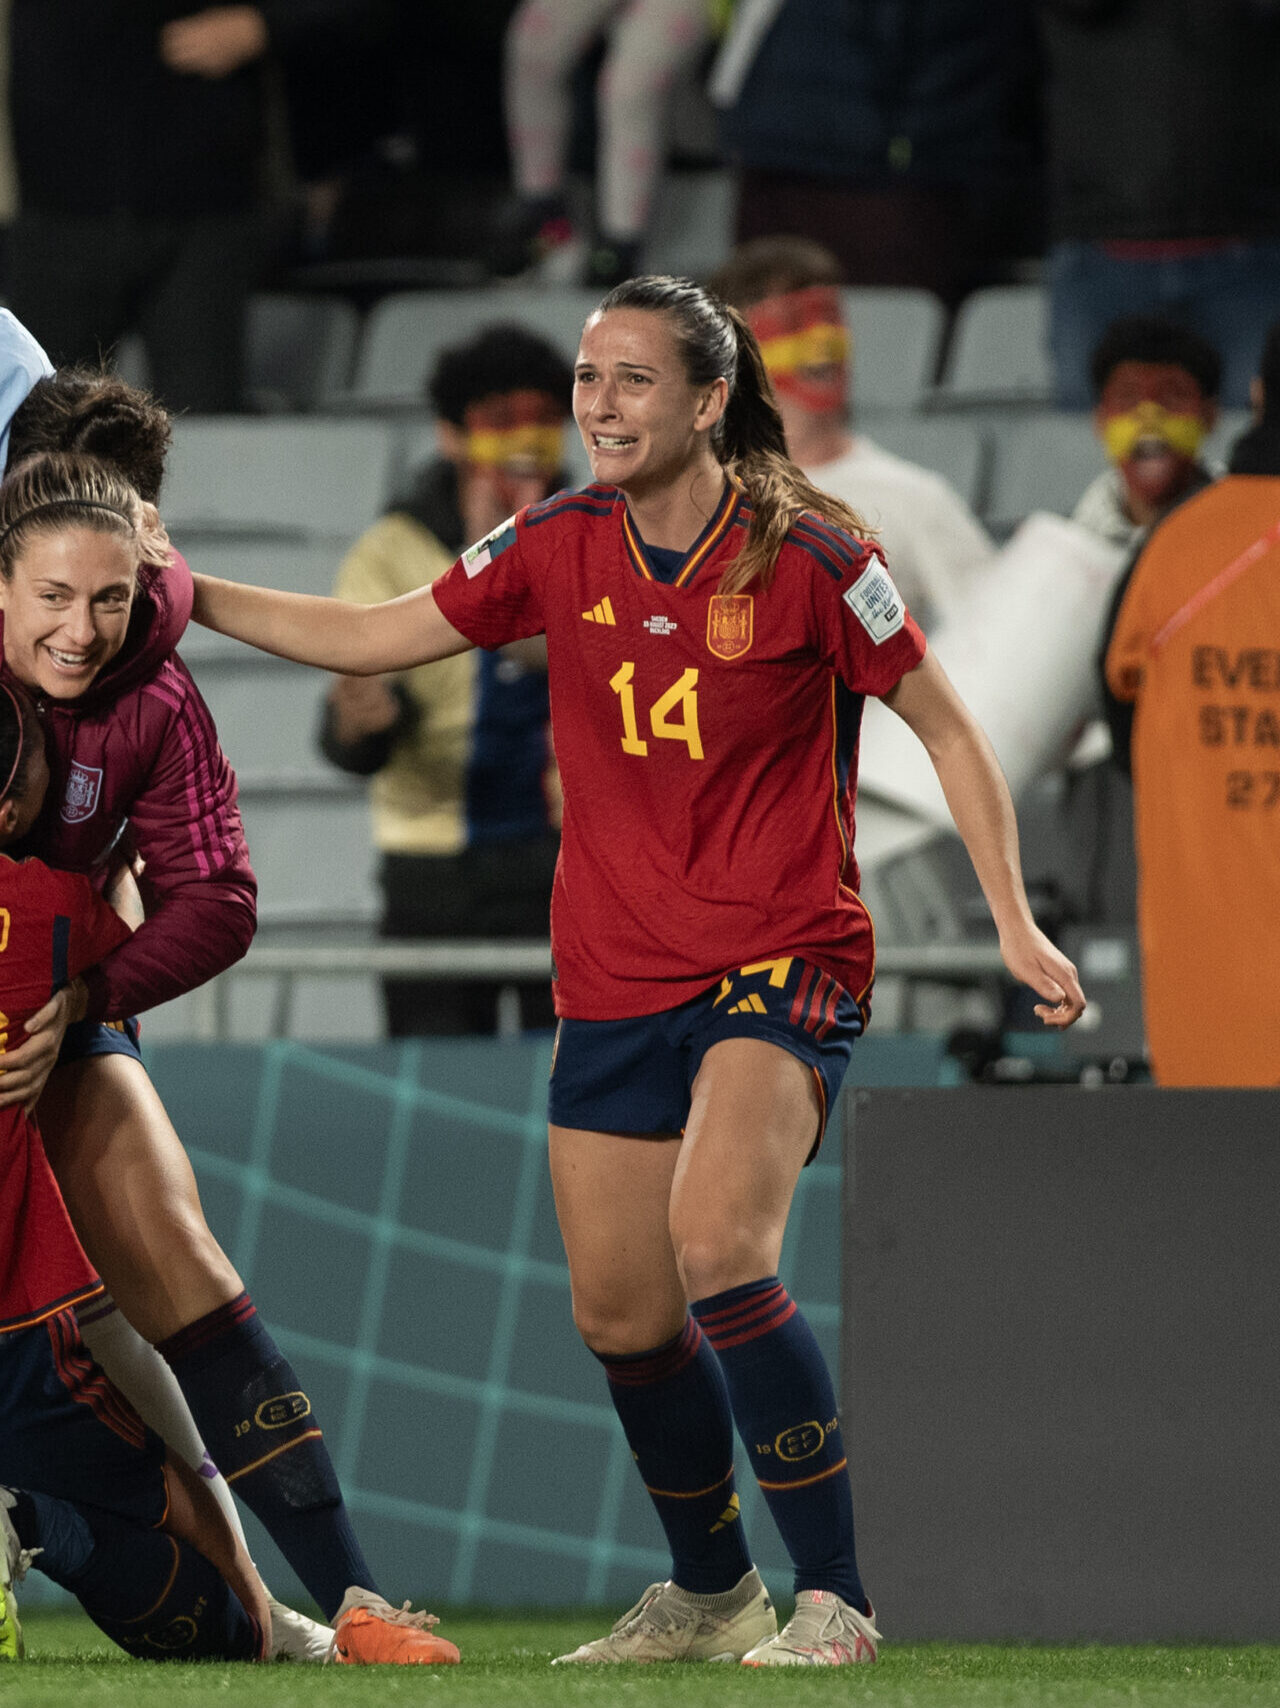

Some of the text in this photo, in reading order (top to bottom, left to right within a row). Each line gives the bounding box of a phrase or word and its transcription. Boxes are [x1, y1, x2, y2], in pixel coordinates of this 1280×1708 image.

[865, 580, 889, 609] UNITES
[1192, 645, 1280, 692] EVE
[609, 661, 705, 760] 14
